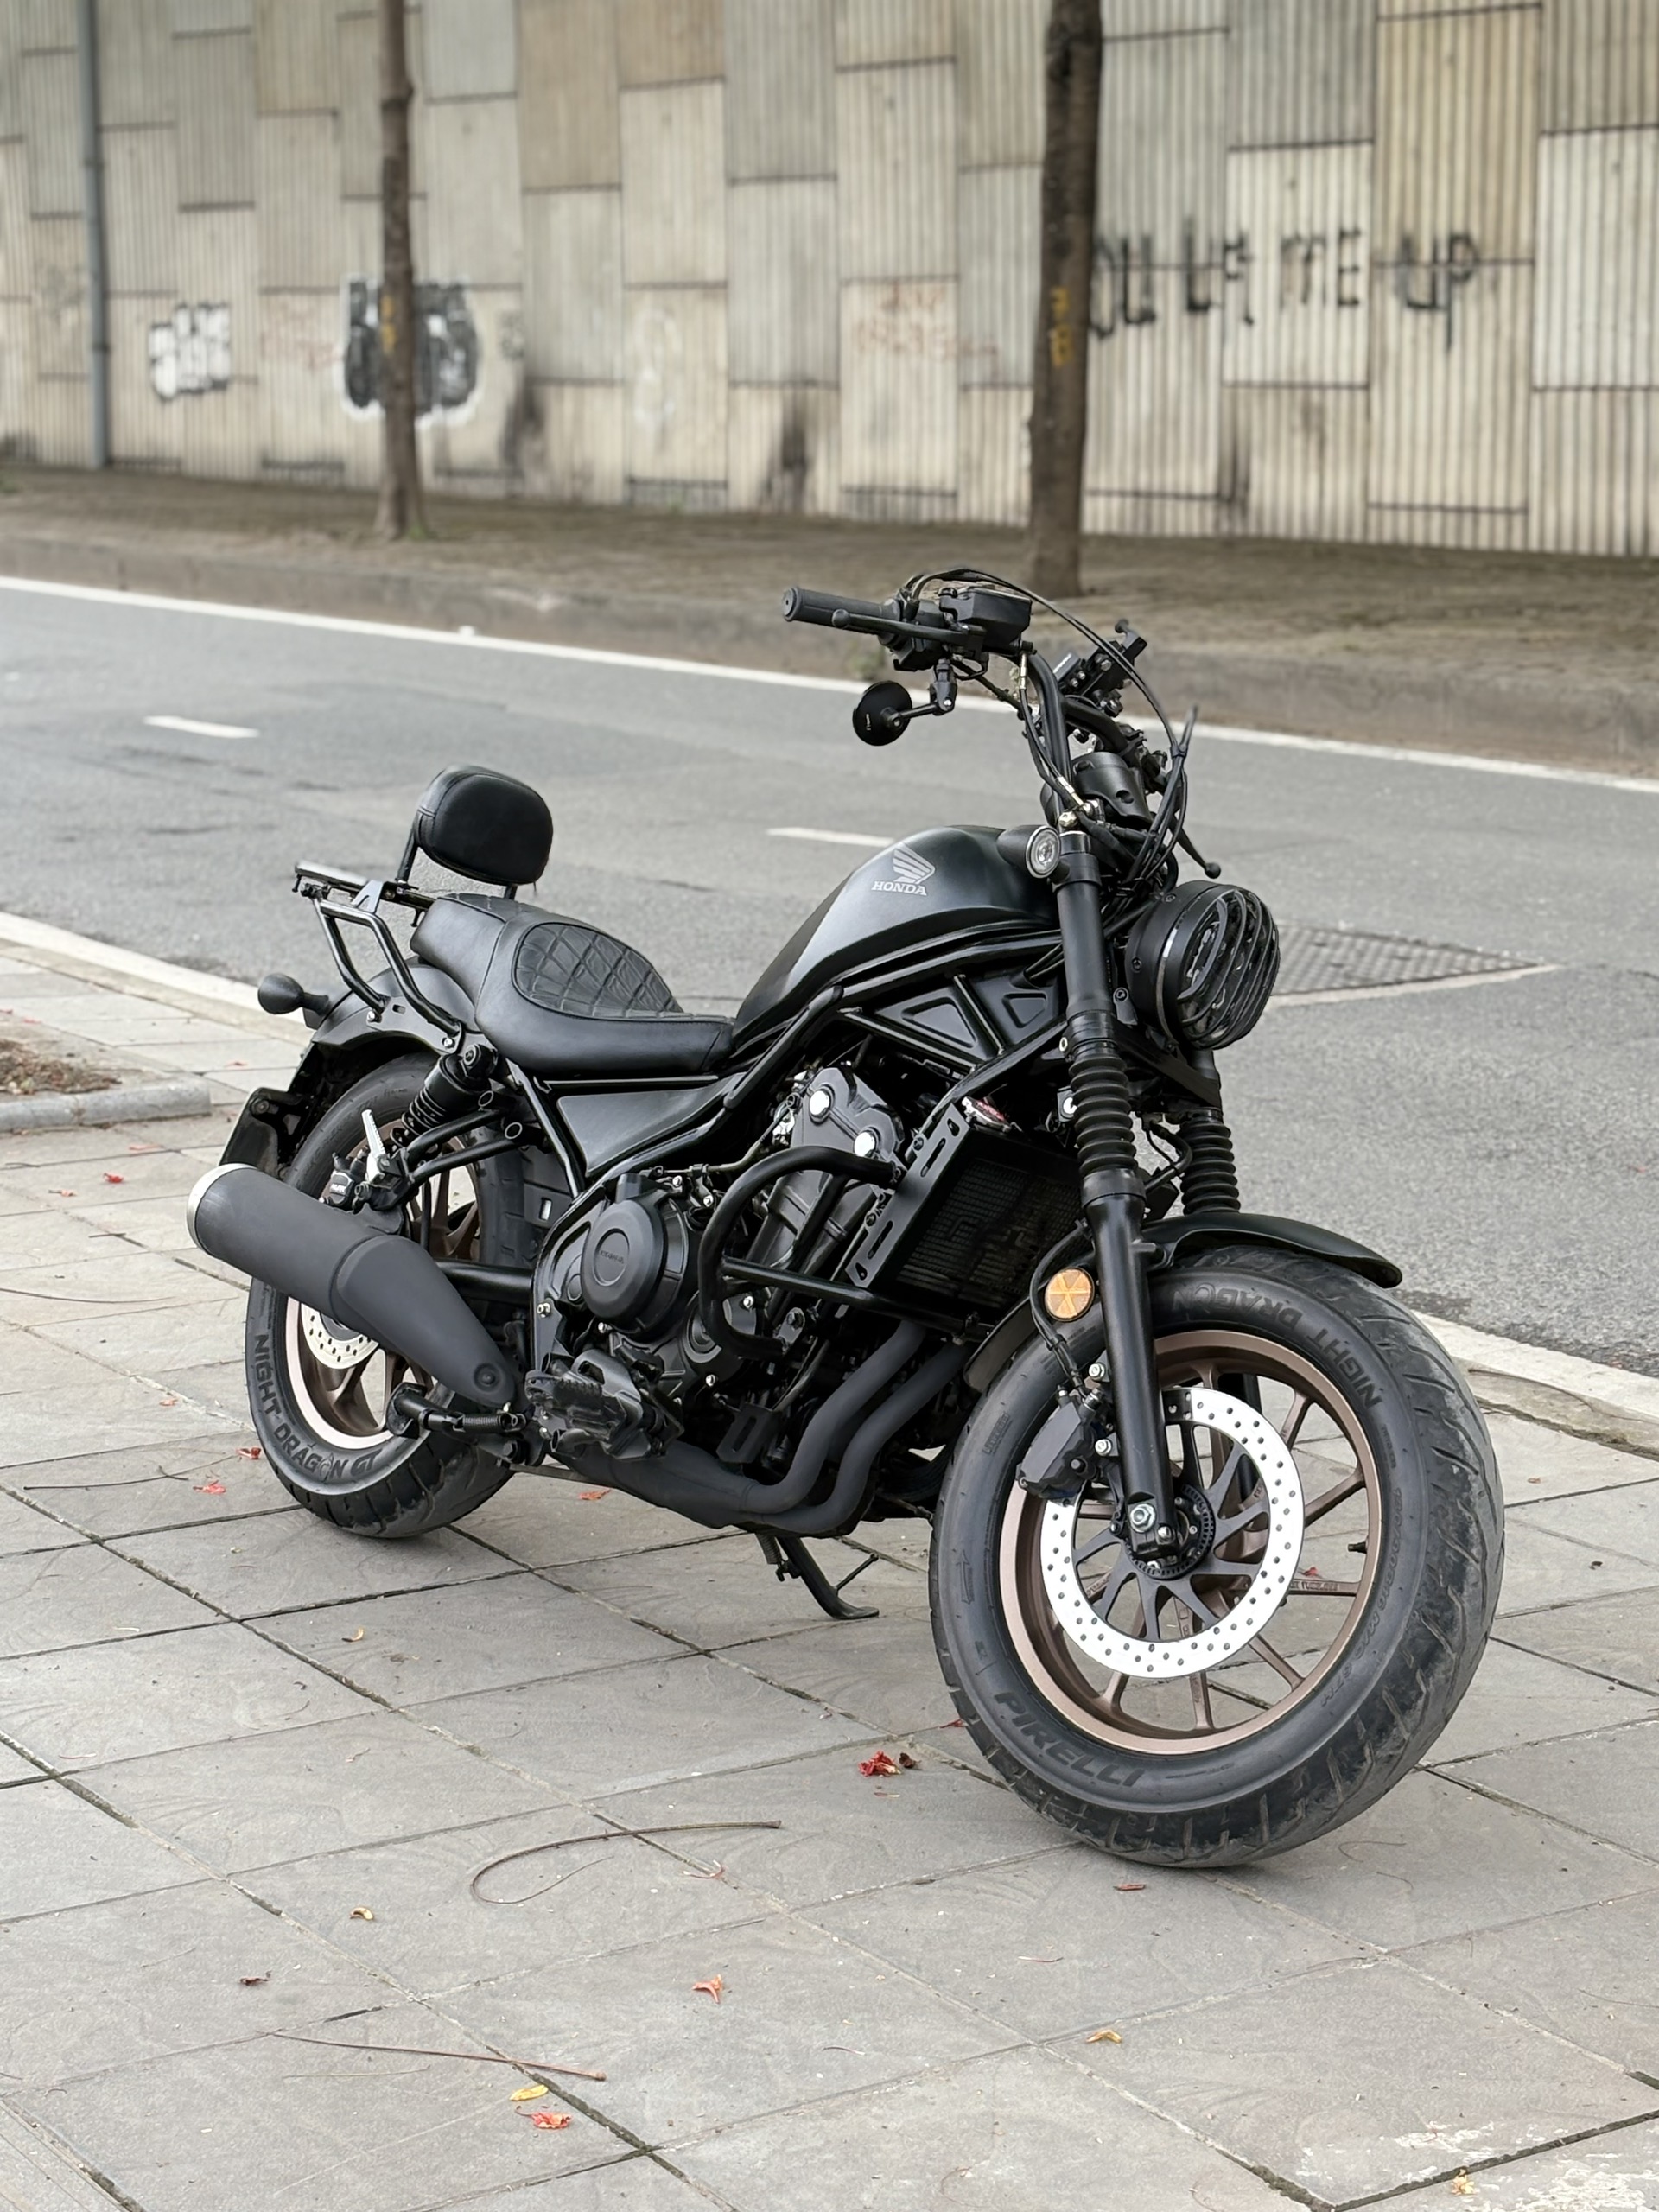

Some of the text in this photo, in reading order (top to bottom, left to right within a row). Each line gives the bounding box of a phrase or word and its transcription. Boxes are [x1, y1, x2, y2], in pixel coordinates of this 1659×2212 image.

[1280, 228, 1363, 309] ME
[1400, 233, 1479, 352] UP
[870, 880, 927, 896] HONDA
[253, 1334, 282, 1417] NIGHT
[274, 1426, 349, 1480] DRAGON
[1172, 1283, 1384, 1409] NIGHT DRAGON
[994, 1692, 1146, 1787] PIRELLI
